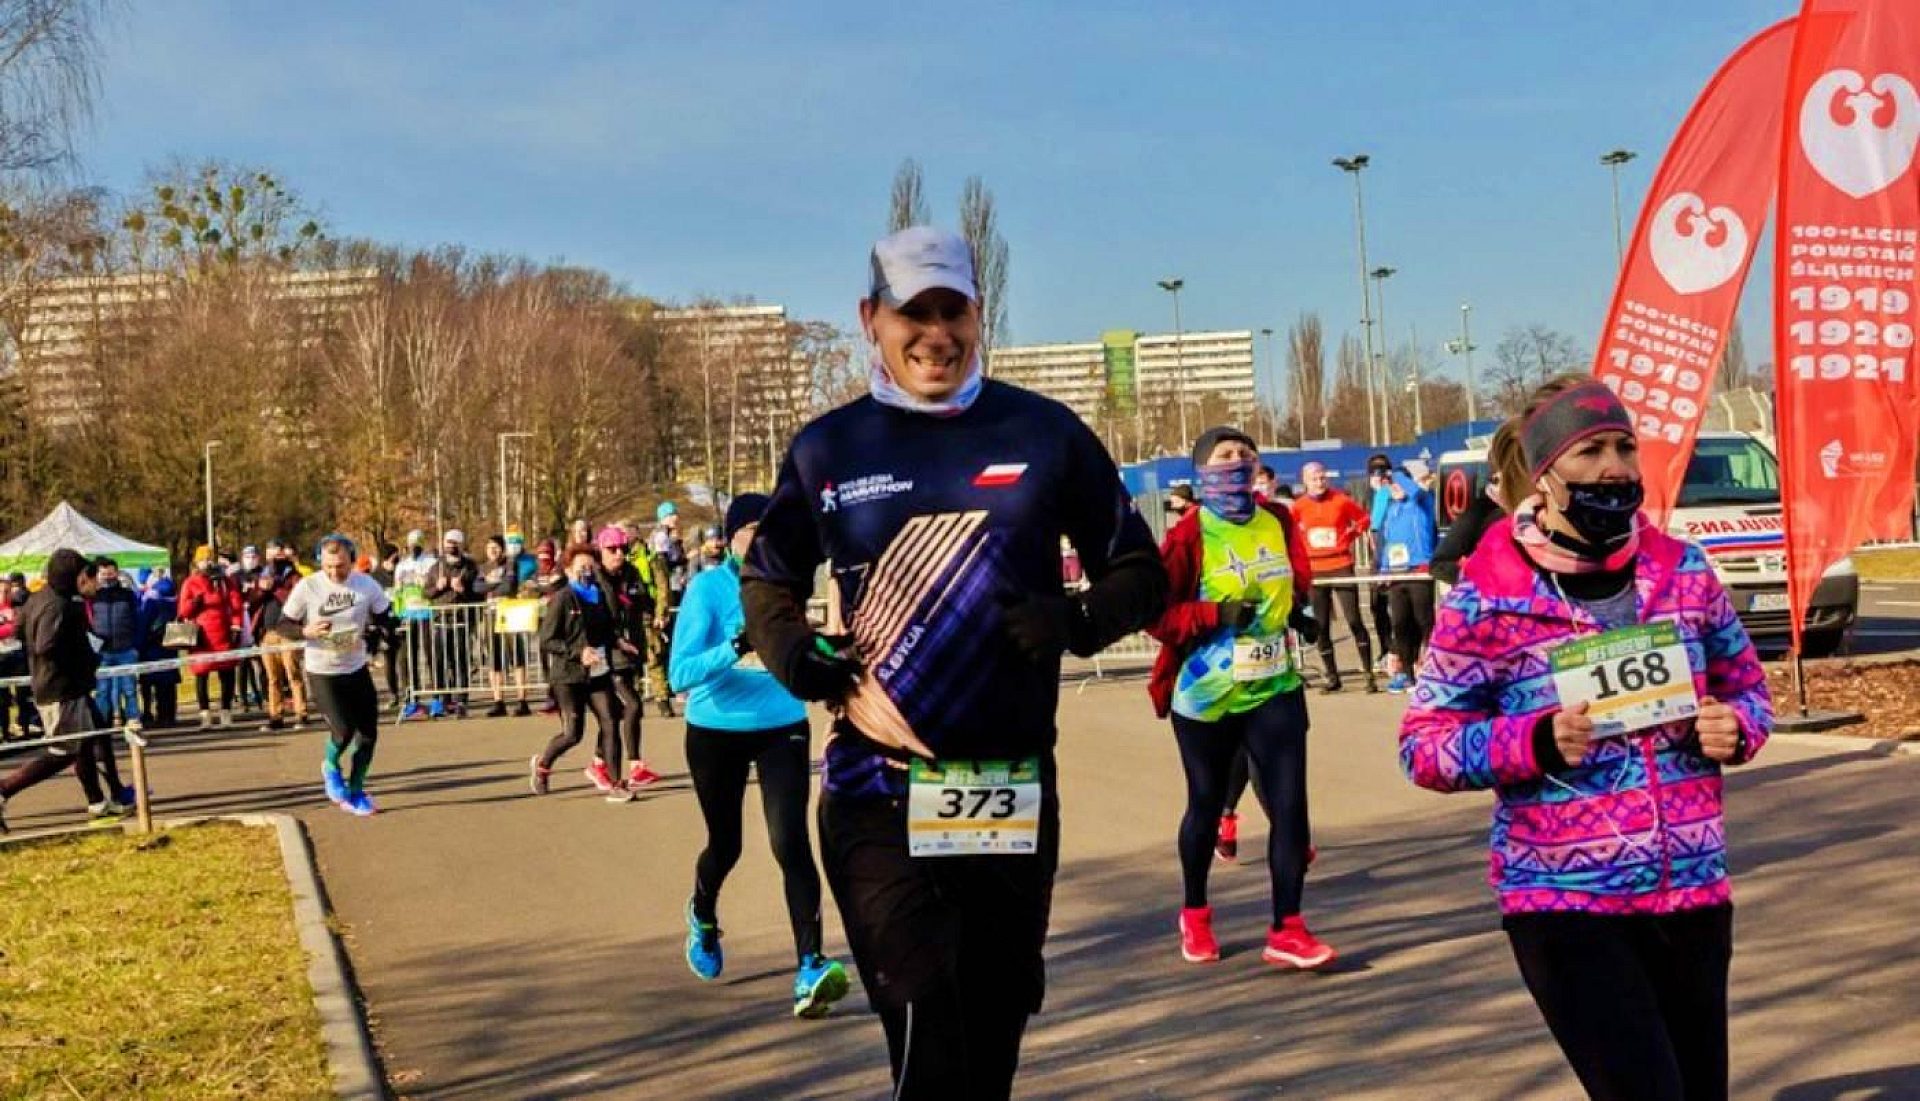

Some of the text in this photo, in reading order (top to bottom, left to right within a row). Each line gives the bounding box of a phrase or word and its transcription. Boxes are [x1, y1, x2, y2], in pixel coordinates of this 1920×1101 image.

[1791, 225, 1917, 242] 100-LECIE
[1791, 243, 1916, 262] POWSTAŃ
[1790, 285, 1910, 314] 1919
[1624, 300, 1719, 340] 100-LECIE
[1790, 320, 1914, 348] 1920
[1610, 348, 1702, 392] 1919
[1790, 354, 1906, 382] 1921
[1602, 373, 1699, 420] 1920
[1590, 652, 1670, 699] 168
[937, 787, 1016, 818] 373
